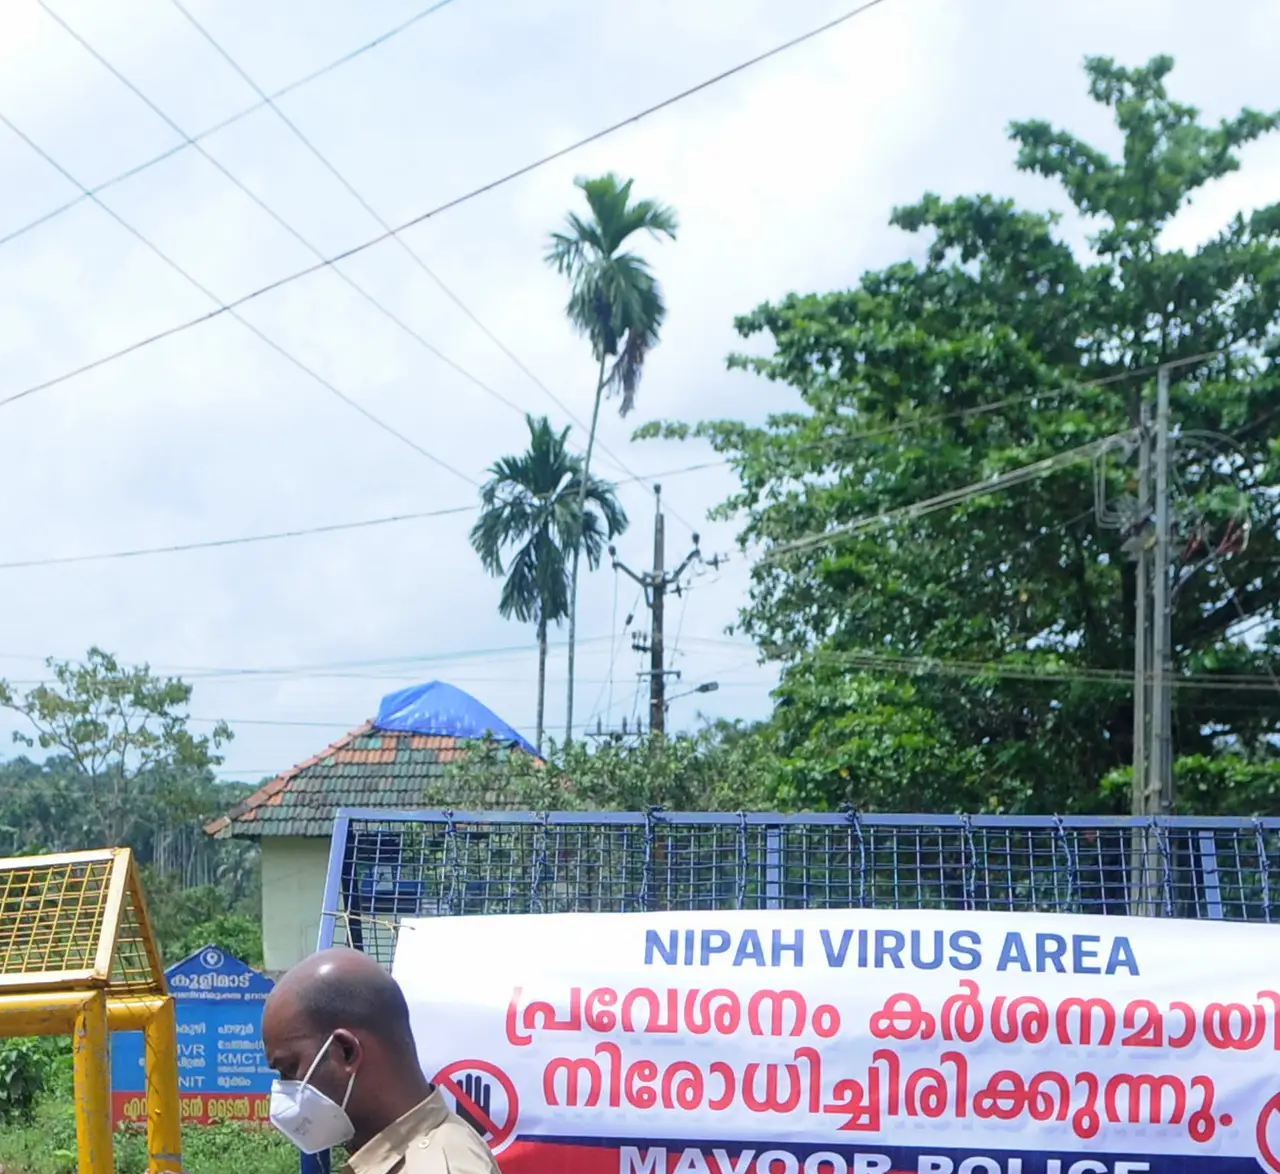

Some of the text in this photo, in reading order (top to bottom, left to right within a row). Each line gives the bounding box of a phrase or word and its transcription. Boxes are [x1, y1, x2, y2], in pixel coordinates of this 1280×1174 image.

[643, 928, 1140, 976] NIPAH VIRUS AREA
[505, 985, 842, 1047] പ്രവേശനം
[217, 1053, 262, 1064] KMCT
